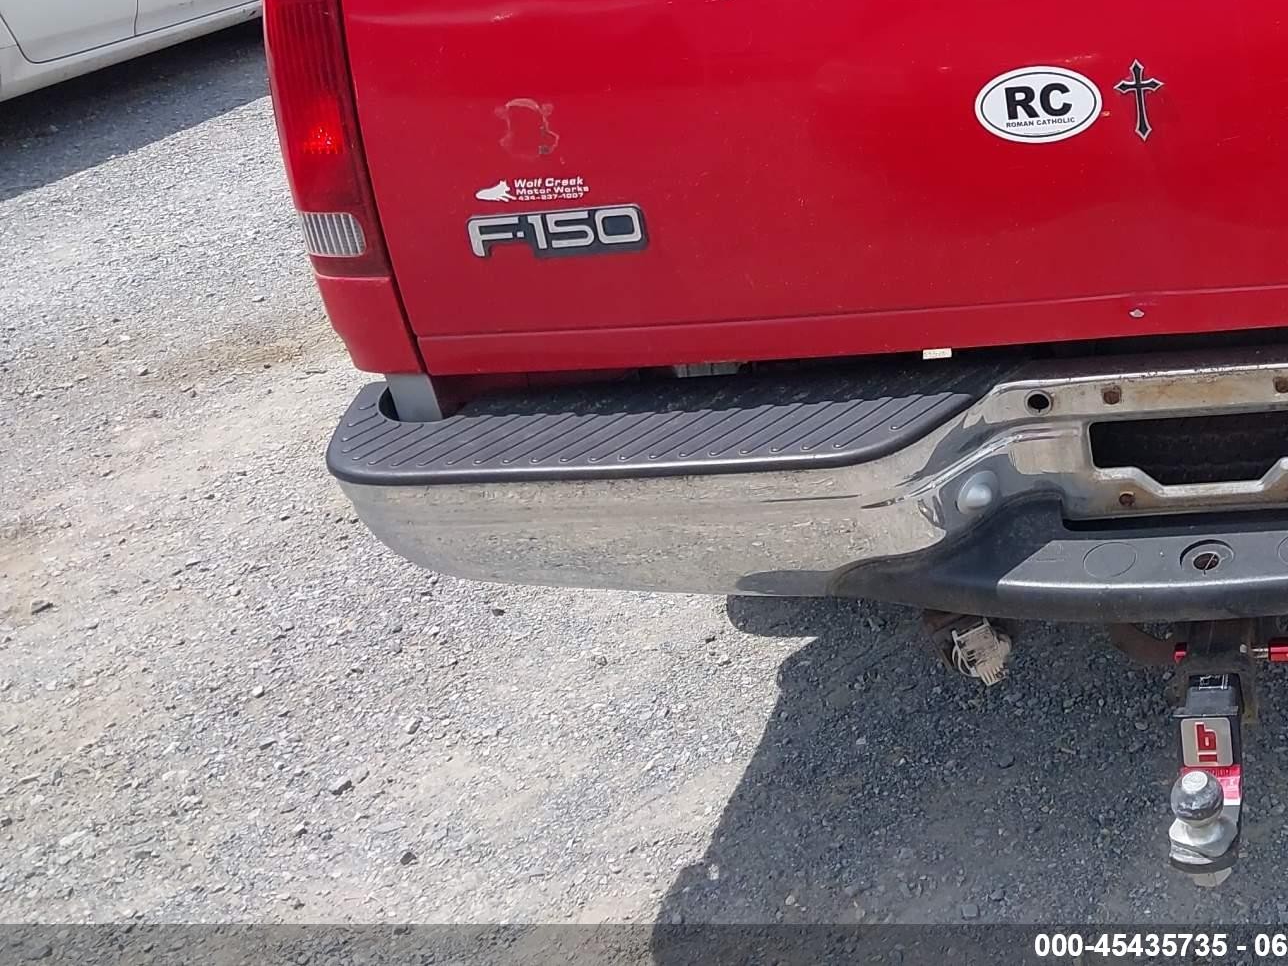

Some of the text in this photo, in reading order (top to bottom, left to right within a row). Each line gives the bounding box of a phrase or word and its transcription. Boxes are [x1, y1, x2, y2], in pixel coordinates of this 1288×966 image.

[1004, 82, 1073, 120] RC
[1006, 117, 1075, 128] ROMAN CATHOLIC
[514, 176, 583, 189] Wolf Creek
[516, 185, 589, 196] Motor Works
[468, 207, 642, 257] F-150
